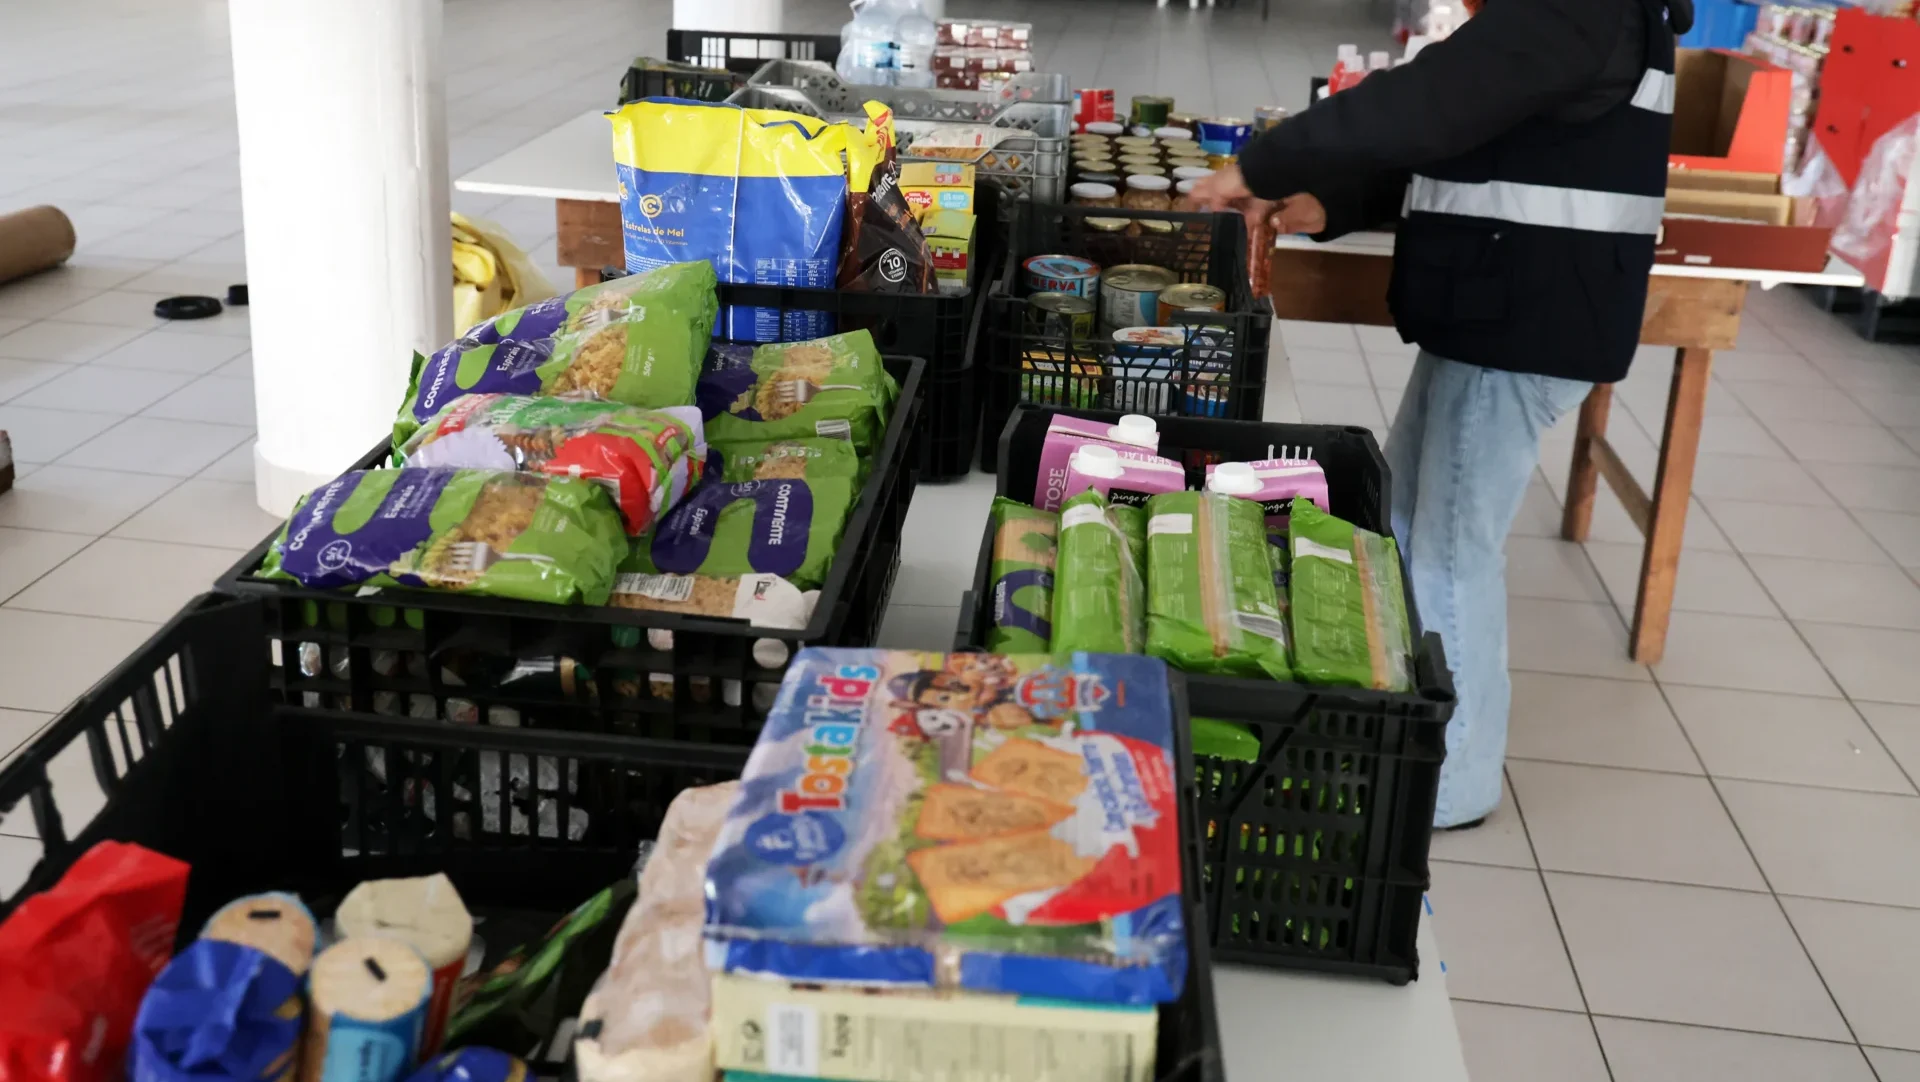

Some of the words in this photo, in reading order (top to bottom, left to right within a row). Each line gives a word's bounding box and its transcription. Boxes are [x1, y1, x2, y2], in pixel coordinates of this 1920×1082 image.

[624, 220, 652, 234] Estrelas
[653, 227, 665, 236] de
[667, 228, 684, 237] Mel
[886, 256, 901, 270] 10
[496, 346, 521, 371] Espirais
[1148, 455, 1173, 467] SEM
[1046, 467, 1065, 511] TOSE
[1111, 491, 1140, 505] pingo
[768, 483, 792, 546] CONTINENTE
[1264, 501, 1286, 513] ingo
[688, 507, 709, 537] Espirais
[776, 663, 881, 814] Tostakids
